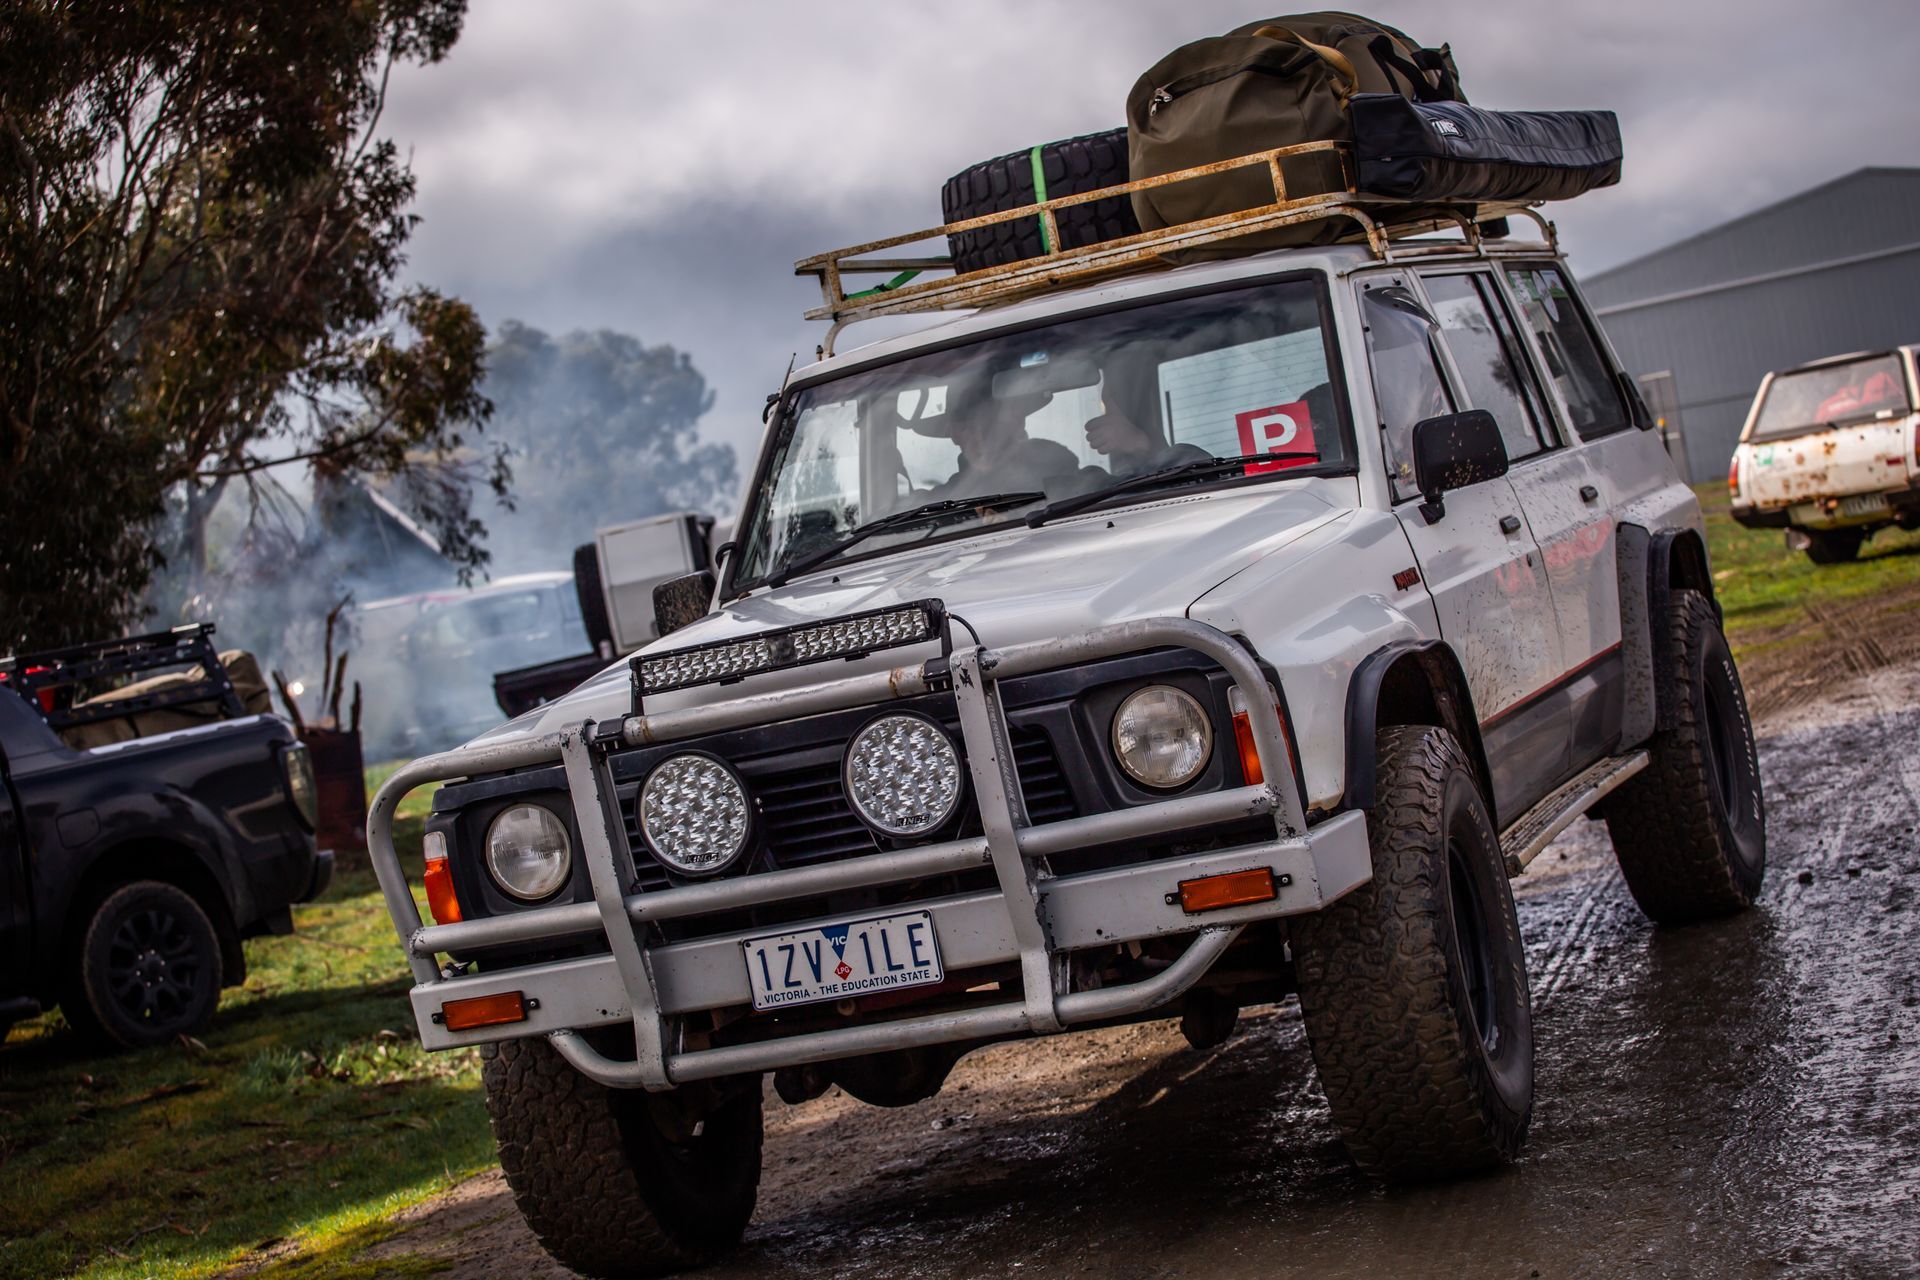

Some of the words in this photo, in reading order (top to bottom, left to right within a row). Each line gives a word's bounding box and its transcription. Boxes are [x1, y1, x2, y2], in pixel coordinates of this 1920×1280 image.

[1251, 413, 1297, 465] P
[685, 853, 719, 864] KINGS
[757, 939, 823, 991] 1ZV
[859, 922, 931, 975] 1LE
[827, 935, 848, 946] VIC
[764, 989, 810, 1004] VICTORIA
[819, 984, 839, 996] THE
[842, 976, 898, 991] EDUCATION
[900, 969, 931, 982] STATE
